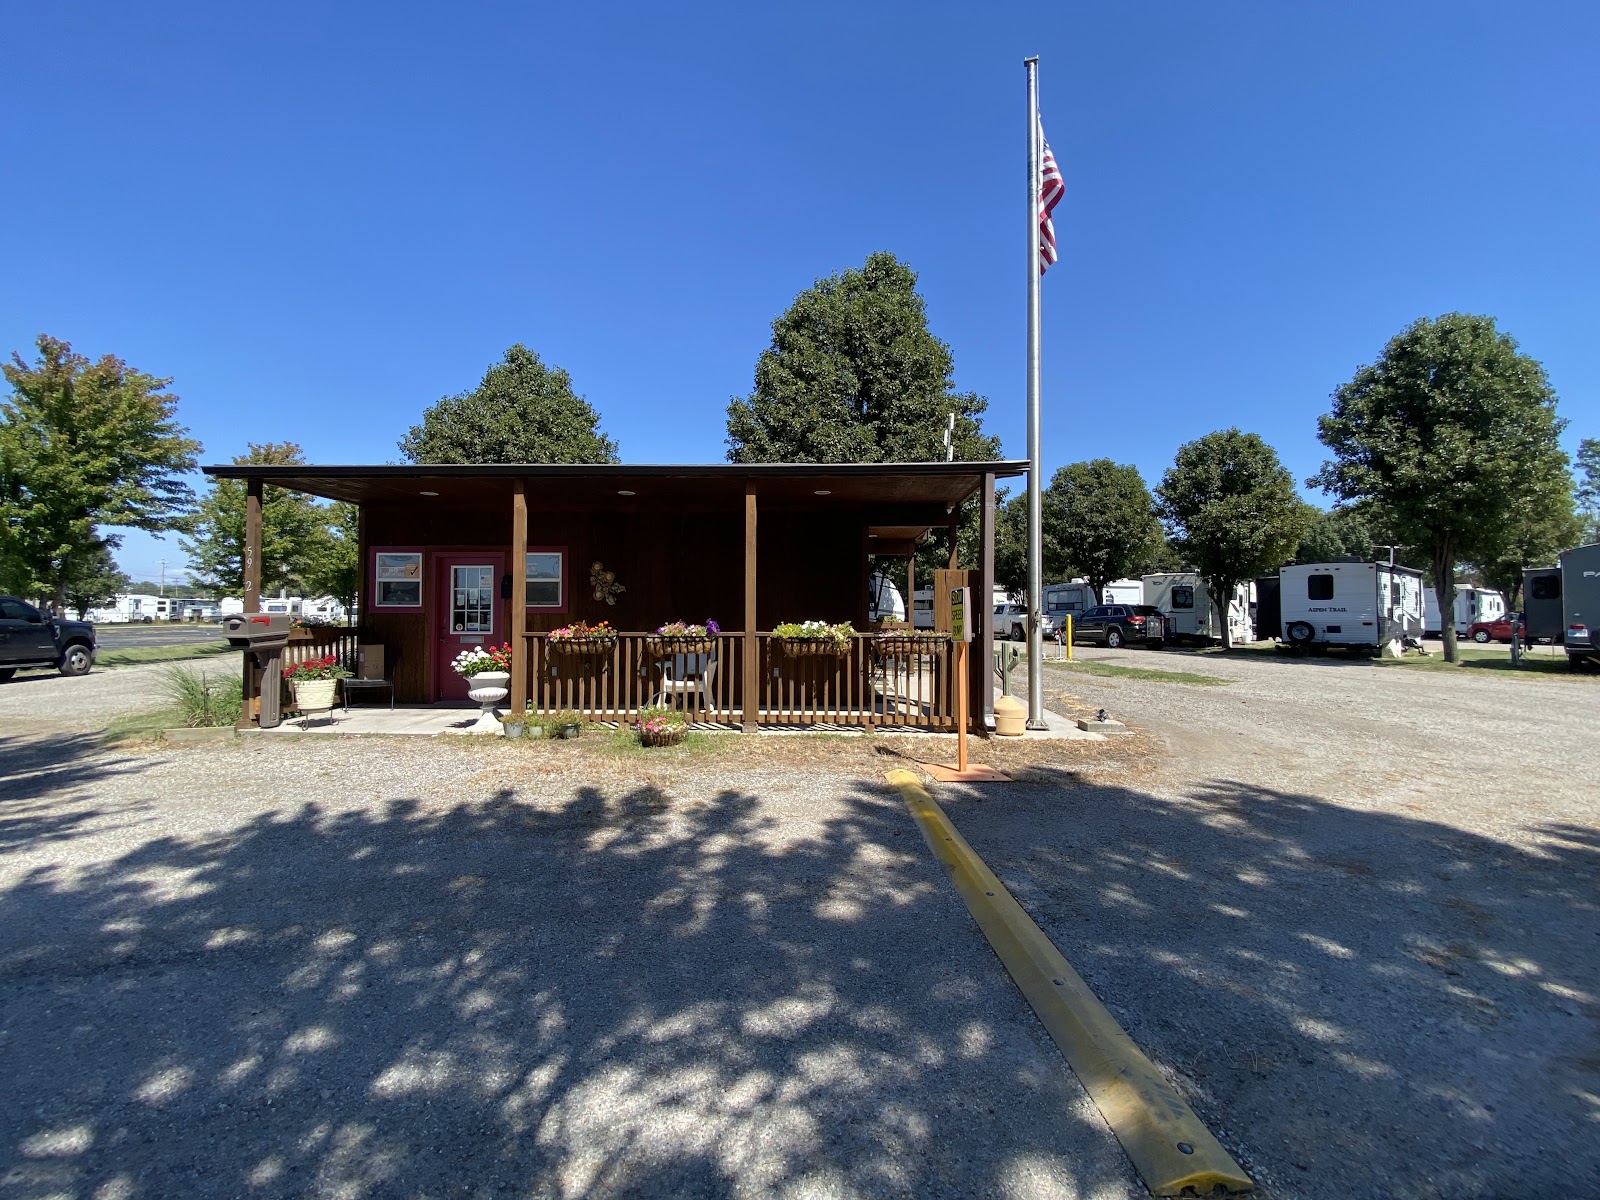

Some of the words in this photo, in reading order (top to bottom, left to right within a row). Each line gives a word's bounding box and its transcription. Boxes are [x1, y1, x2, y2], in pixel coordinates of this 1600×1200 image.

[952, 590, 963, 604] SLOW
[952, 609, 963, 620] SPEED
[952, 624, 963, 636] BUMP
